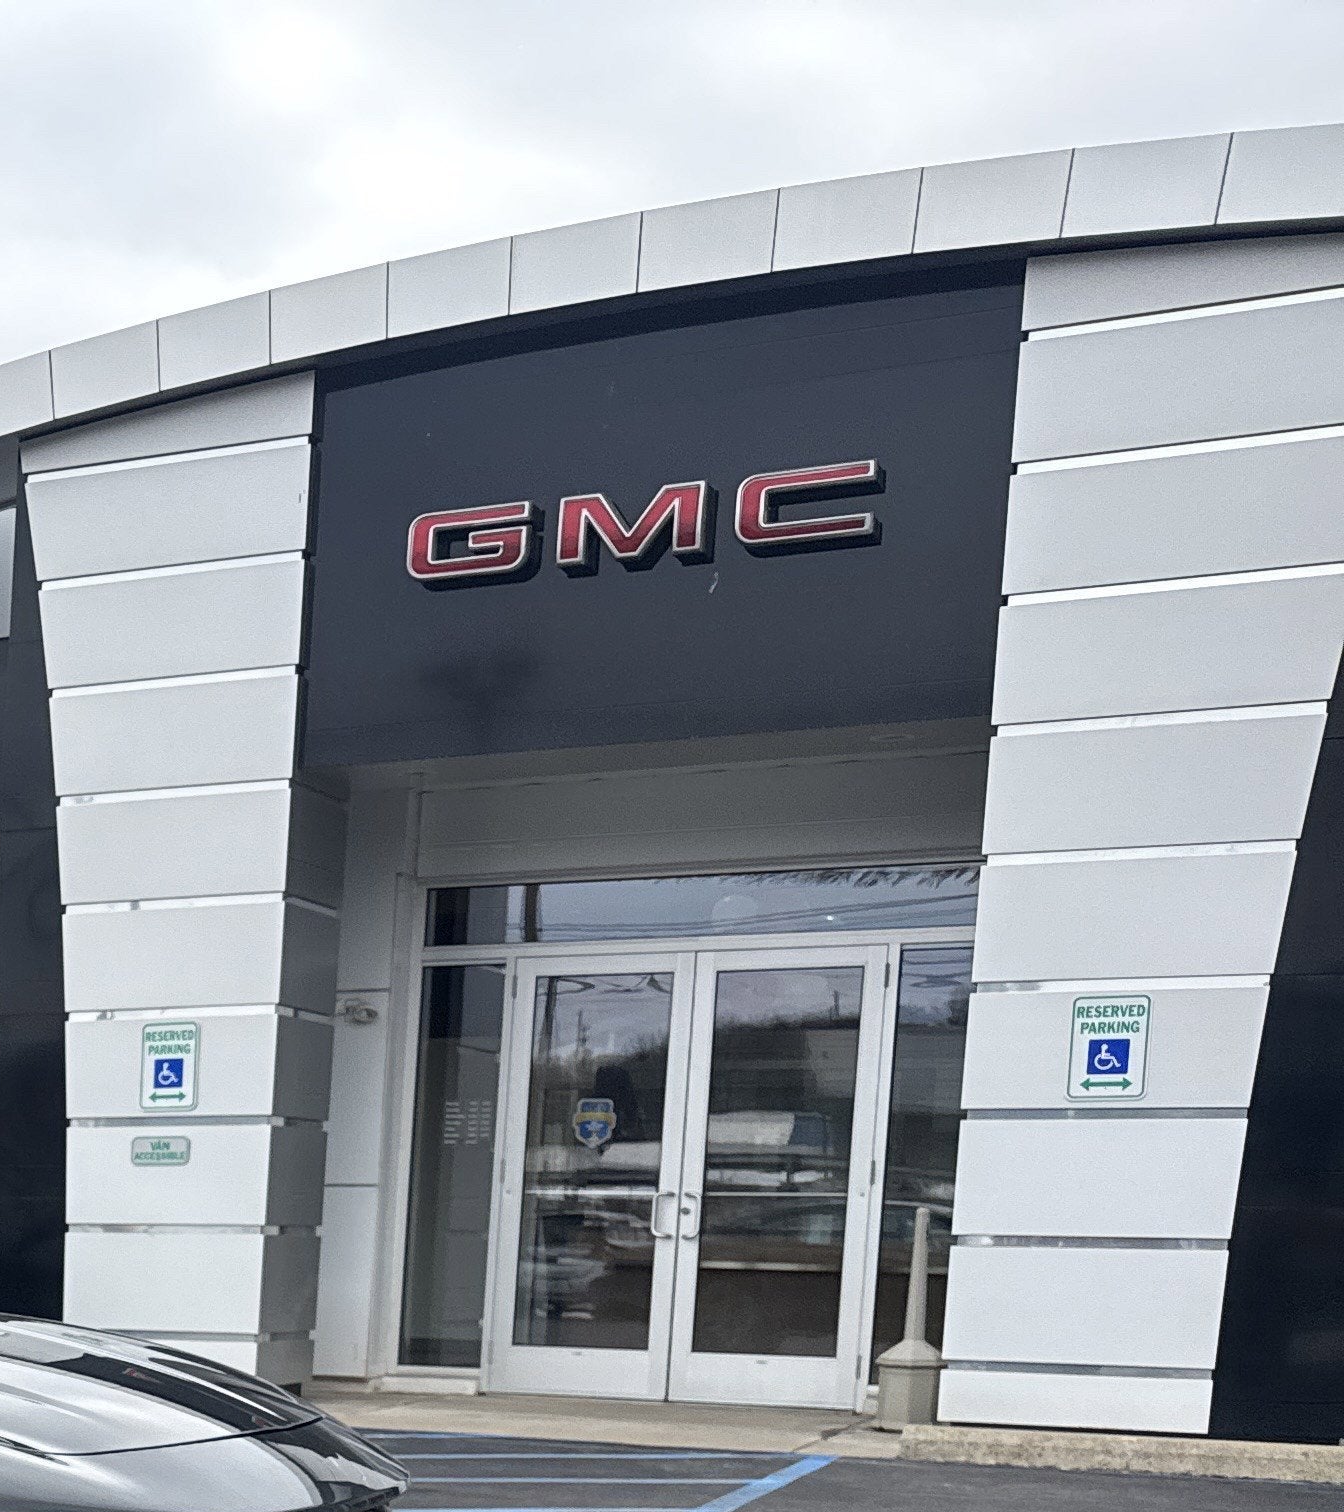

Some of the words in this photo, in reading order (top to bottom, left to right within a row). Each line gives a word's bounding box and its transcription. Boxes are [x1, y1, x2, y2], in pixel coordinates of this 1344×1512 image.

[406, 458, 879, 580] GMC
[1077, 1004, 1145, 1018] RESERVED
[1080, 1021, 1140, 1034] PARKING
[146, 1030, 195, 1042] RESERVED
[149, 1043, 191, 1055] PARKING
[150, 1141, 171, 1150] VAN
